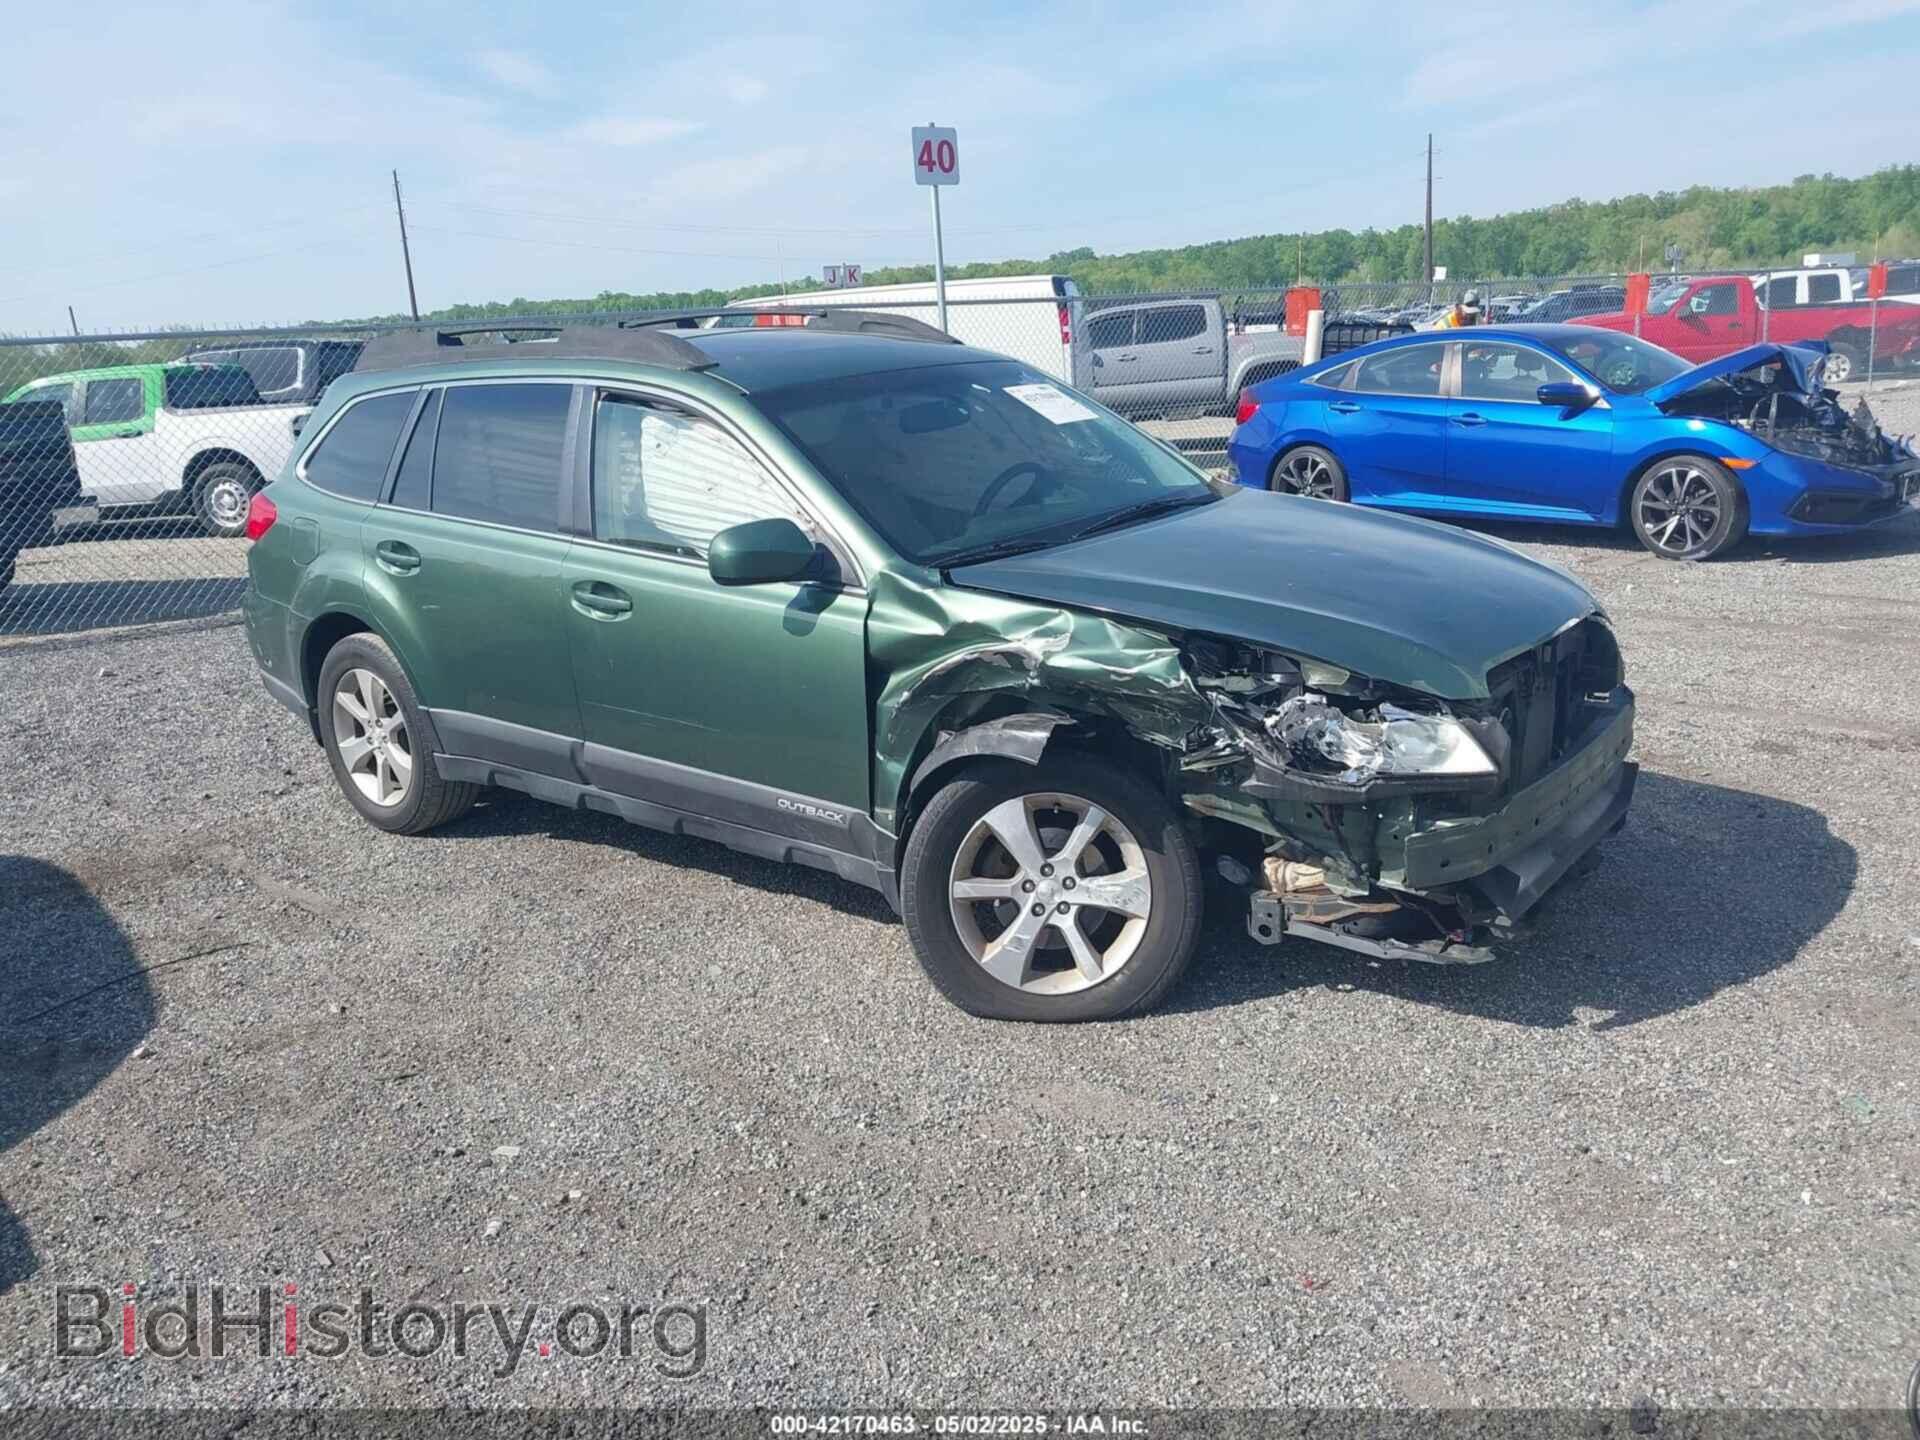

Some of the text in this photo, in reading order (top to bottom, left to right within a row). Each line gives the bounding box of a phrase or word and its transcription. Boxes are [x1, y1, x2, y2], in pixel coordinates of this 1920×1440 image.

[918, 139, 955, 174] 40
[828, 269, 836, 283] J
[848, 268, 858, 282] K
[777, 798, 845, 824] OUTBACK
